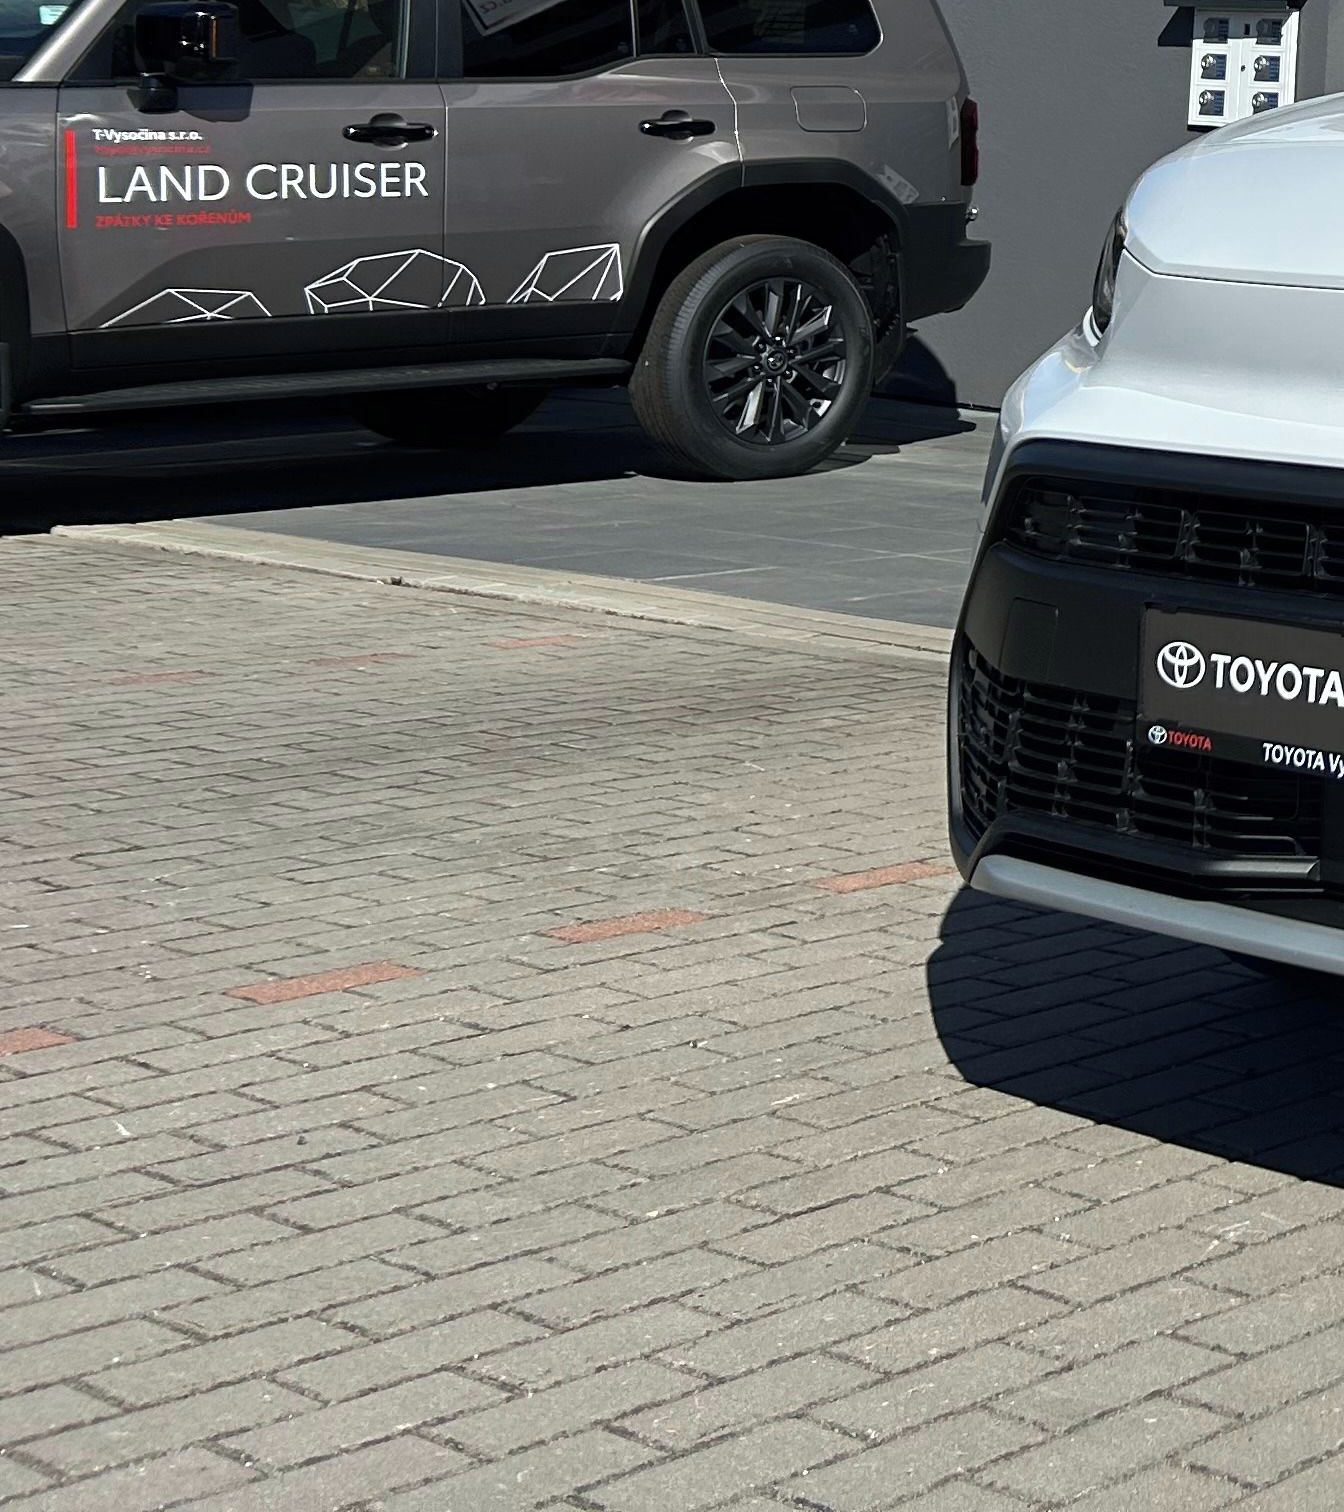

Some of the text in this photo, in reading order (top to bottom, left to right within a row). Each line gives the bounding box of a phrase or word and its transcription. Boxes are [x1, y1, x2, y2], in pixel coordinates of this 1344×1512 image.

[98, 162, 429, 204] LAND CRUISER
[154, 213, 175, 227] KE
[1168, 730, 1213, 752] TOYOTA
[1262, 742, 1325, 772] TOYOTA
